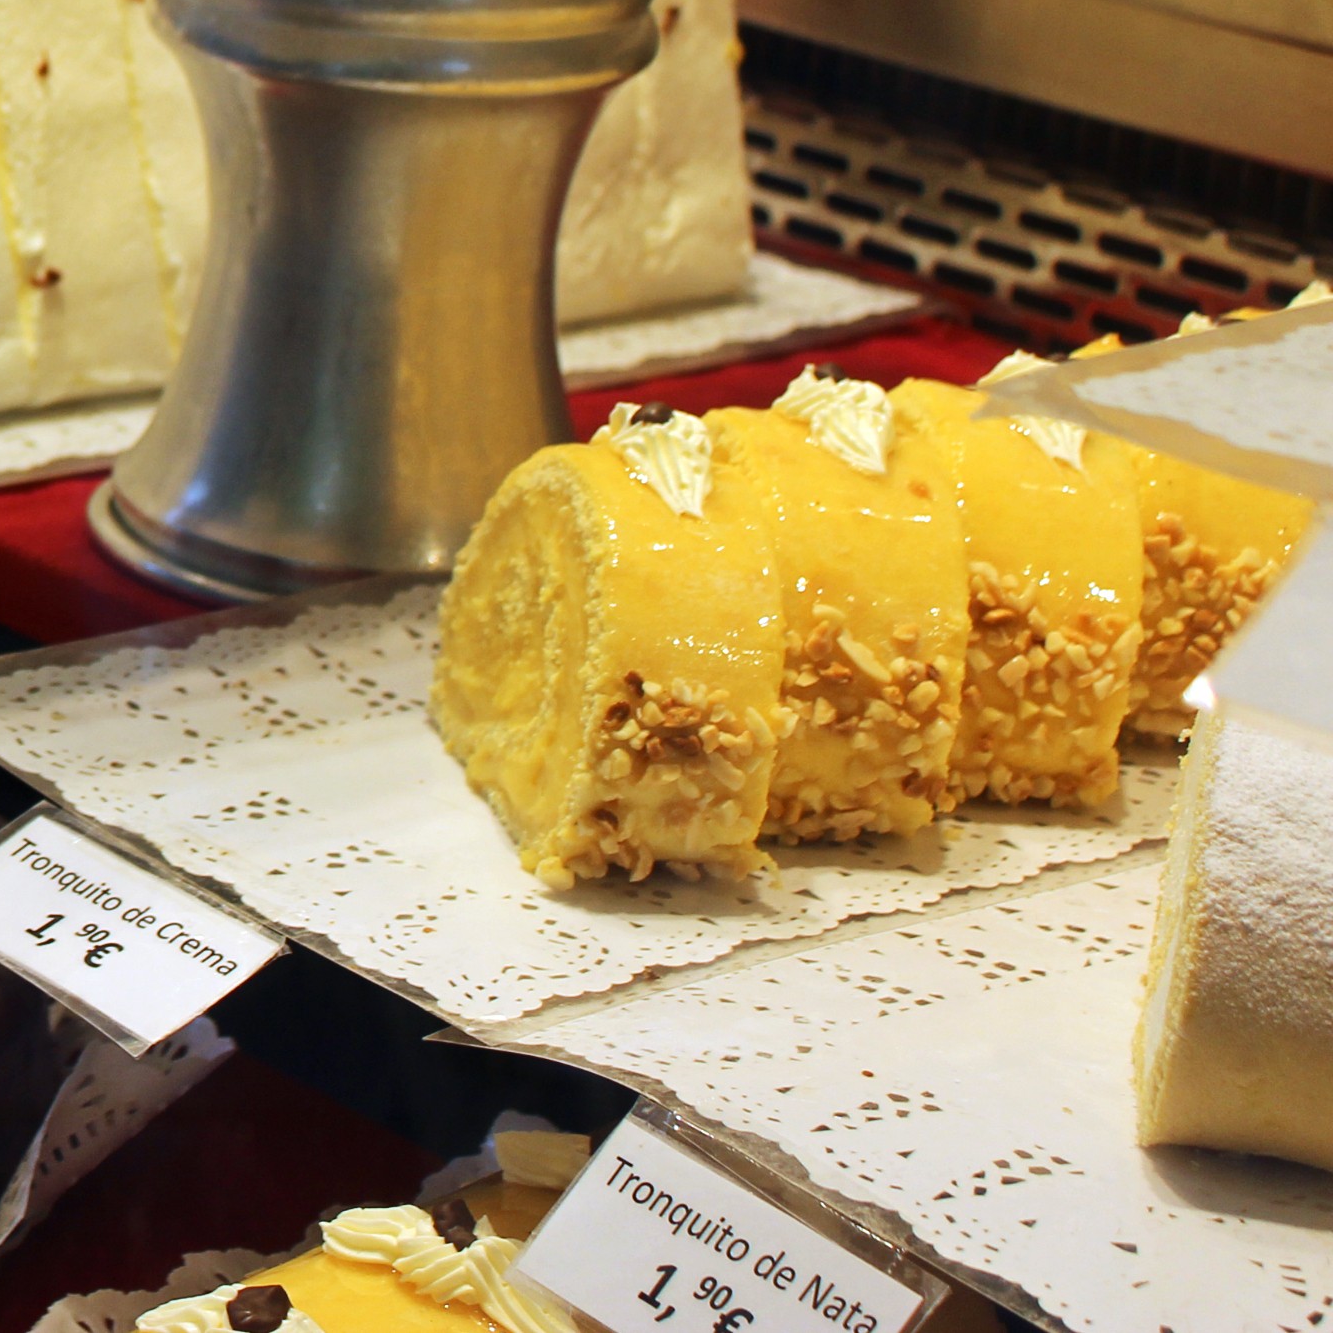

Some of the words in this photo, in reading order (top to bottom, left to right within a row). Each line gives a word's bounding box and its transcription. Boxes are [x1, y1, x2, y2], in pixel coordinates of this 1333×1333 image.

[10, 837, 122, 912] Tronquito
[122, 906, 157, 929] de
[156, 922, 239, 976] Crema
[605, 1155, 751, 1262] Tronquito
[753, 1251, 796, 1290] de
[798, 1274, 877, 1333] Nata
